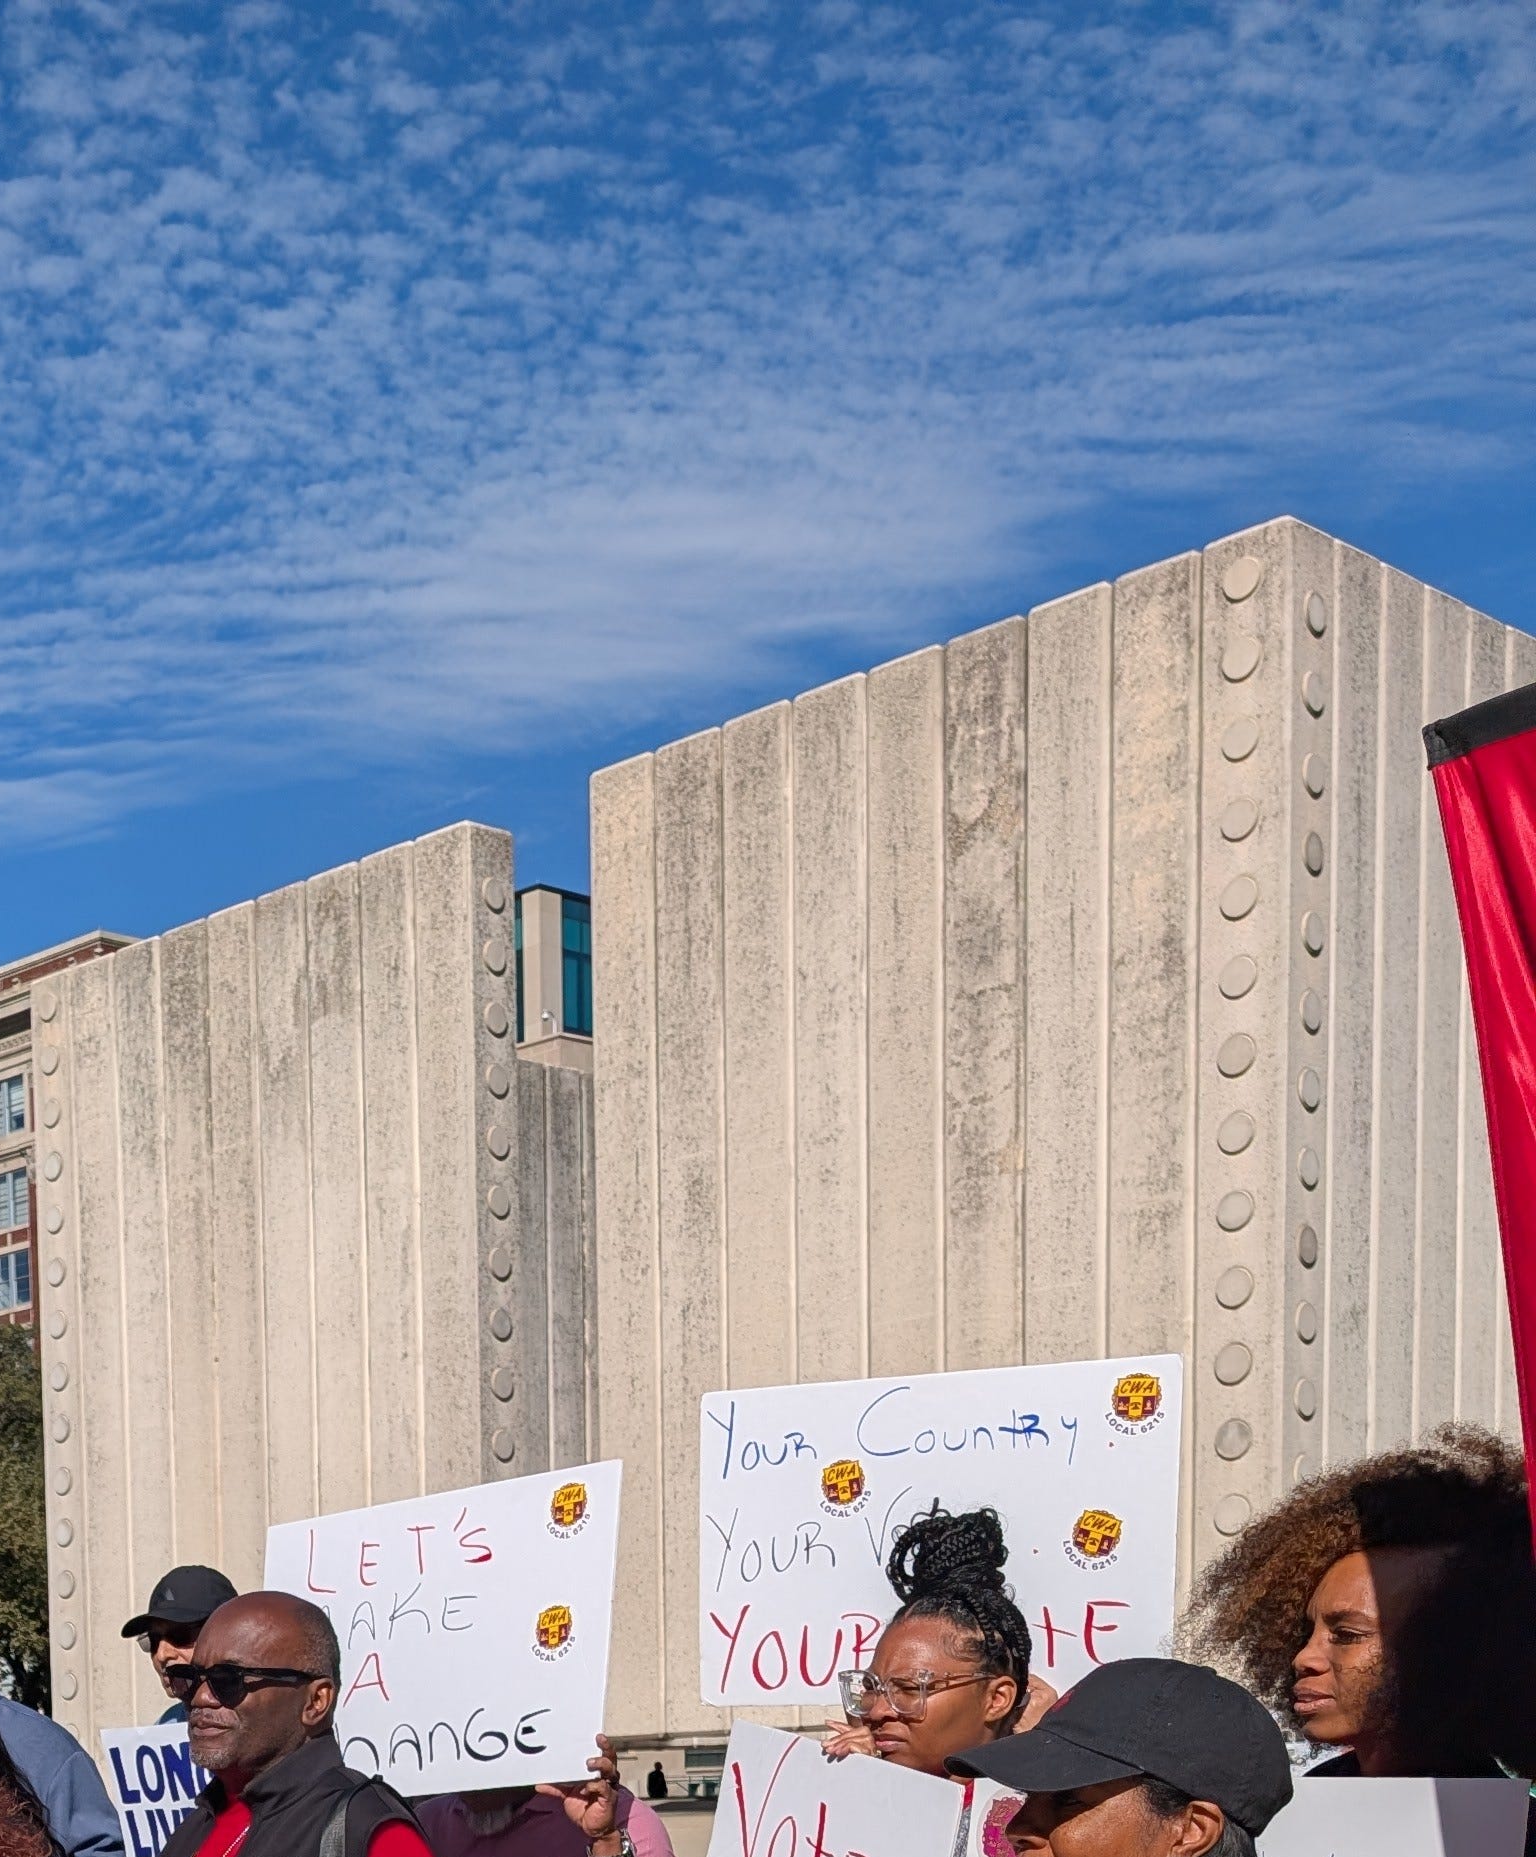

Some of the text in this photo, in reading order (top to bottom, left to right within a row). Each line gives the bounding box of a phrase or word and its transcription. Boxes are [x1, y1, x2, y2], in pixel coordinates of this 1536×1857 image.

[1120, 1380, 1155, 1394] CWA
[1105, 1411, 1137, 1435] LOCAL
[827, 1464, 856, 1482] CWA
[556, 1488, 581, 1504] CWA
[820, 1500, 851, 1518] LOCAL
[546, 1522, 570, 1539] LOCAL
[1083, 1515, 1117, 1533] CWA
[307, 1507, 493, 1594] LET'S
[1063, 1540, 1087, 1570] LOCAL
[322, 1582, 478, 1650] AKE
[532, 1644, 556, 1661] LOCAL
[343, 1652, 390, 1708] A
